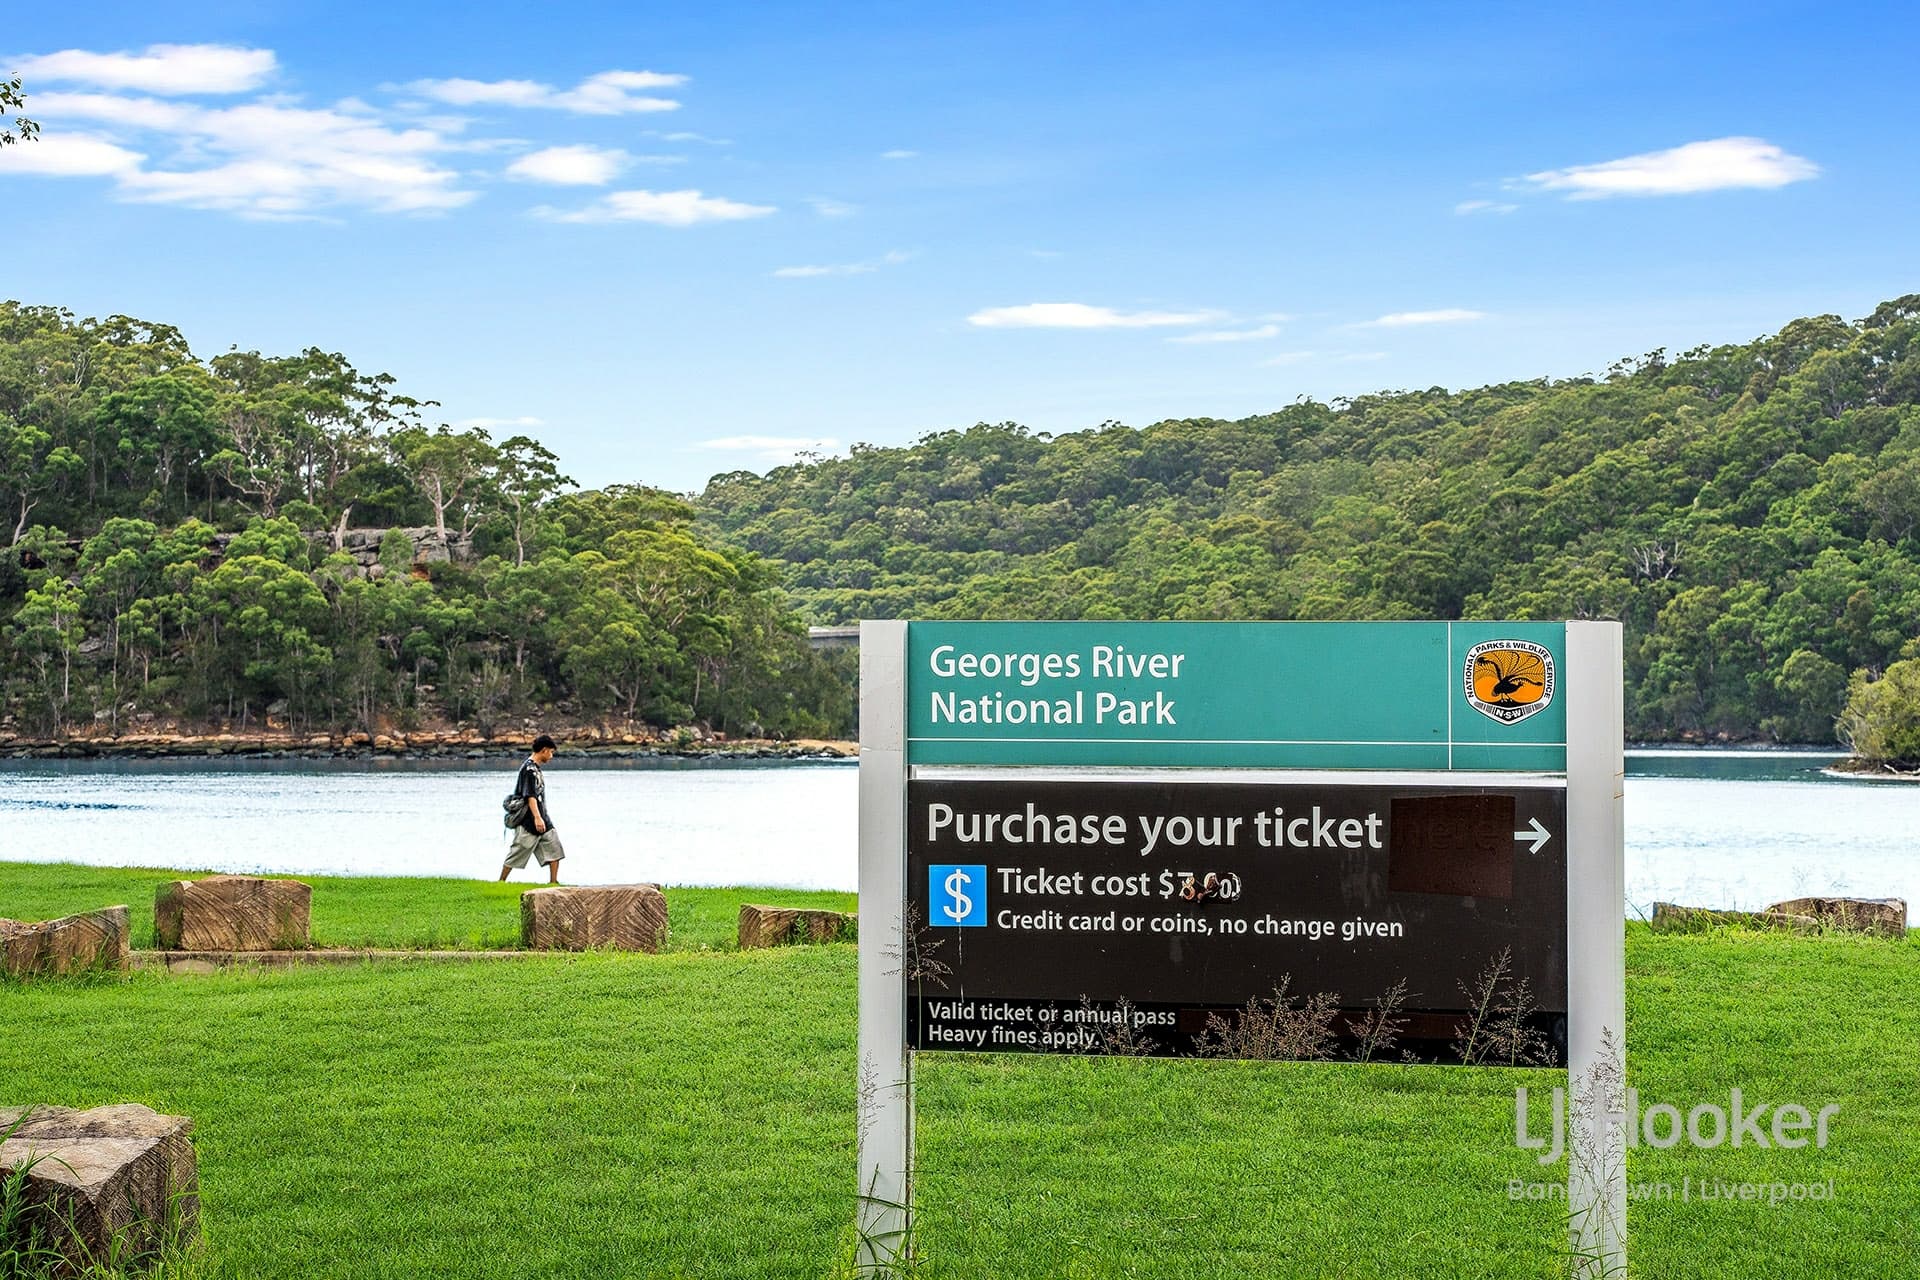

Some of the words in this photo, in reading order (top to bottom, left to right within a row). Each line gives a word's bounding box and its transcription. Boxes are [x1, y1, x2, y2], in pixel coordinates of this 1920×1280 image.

[931, 646, 1080, 685] Georges
[1093, 646, 1184, 677] River
[1465, 653, 1476, 697] NATIONAL
[1475, 642, 1504, 652] PARKS
[1513, 642, 1549, 660] WILDLIFE
[1545, 661, 1553, 699] SERVICE
[932, 691, 1082, 723] National
[1097, 692, 1176, 724] Park
[929, 803, 1126, 844] Purchase
[1139, 817, 1242, 856] your
[1254, 807, 1382, 848] ticket
[998, 868, 1083, 894] Ticket
[1092, 873, 1150, 896] cost
[998, 910, 1062, 929] Credit
[1069, 912, 1114, 930] card
[1122, 917, 1144, 931] or
[1151, 913, 1212, 935] coins,
[1220, 919, 1247, 933] no
[1254, 915, 1335, 940] change
[1341, 917, 1404, 941] given
[929, 1001, 974, 1019] Valid
[979, 1002, 1034, 1022] ticket
[1038, 1008, 1058, 1022] or
[1063, 1006, 1128, 1024] annual
[1134, 1007, 1176, 1030] pass
[930, 1025, 986, 1046] Heavy
[991, 1025, 1038, 1044] fines
[1042, 1030, 1100, 1048] apply.
